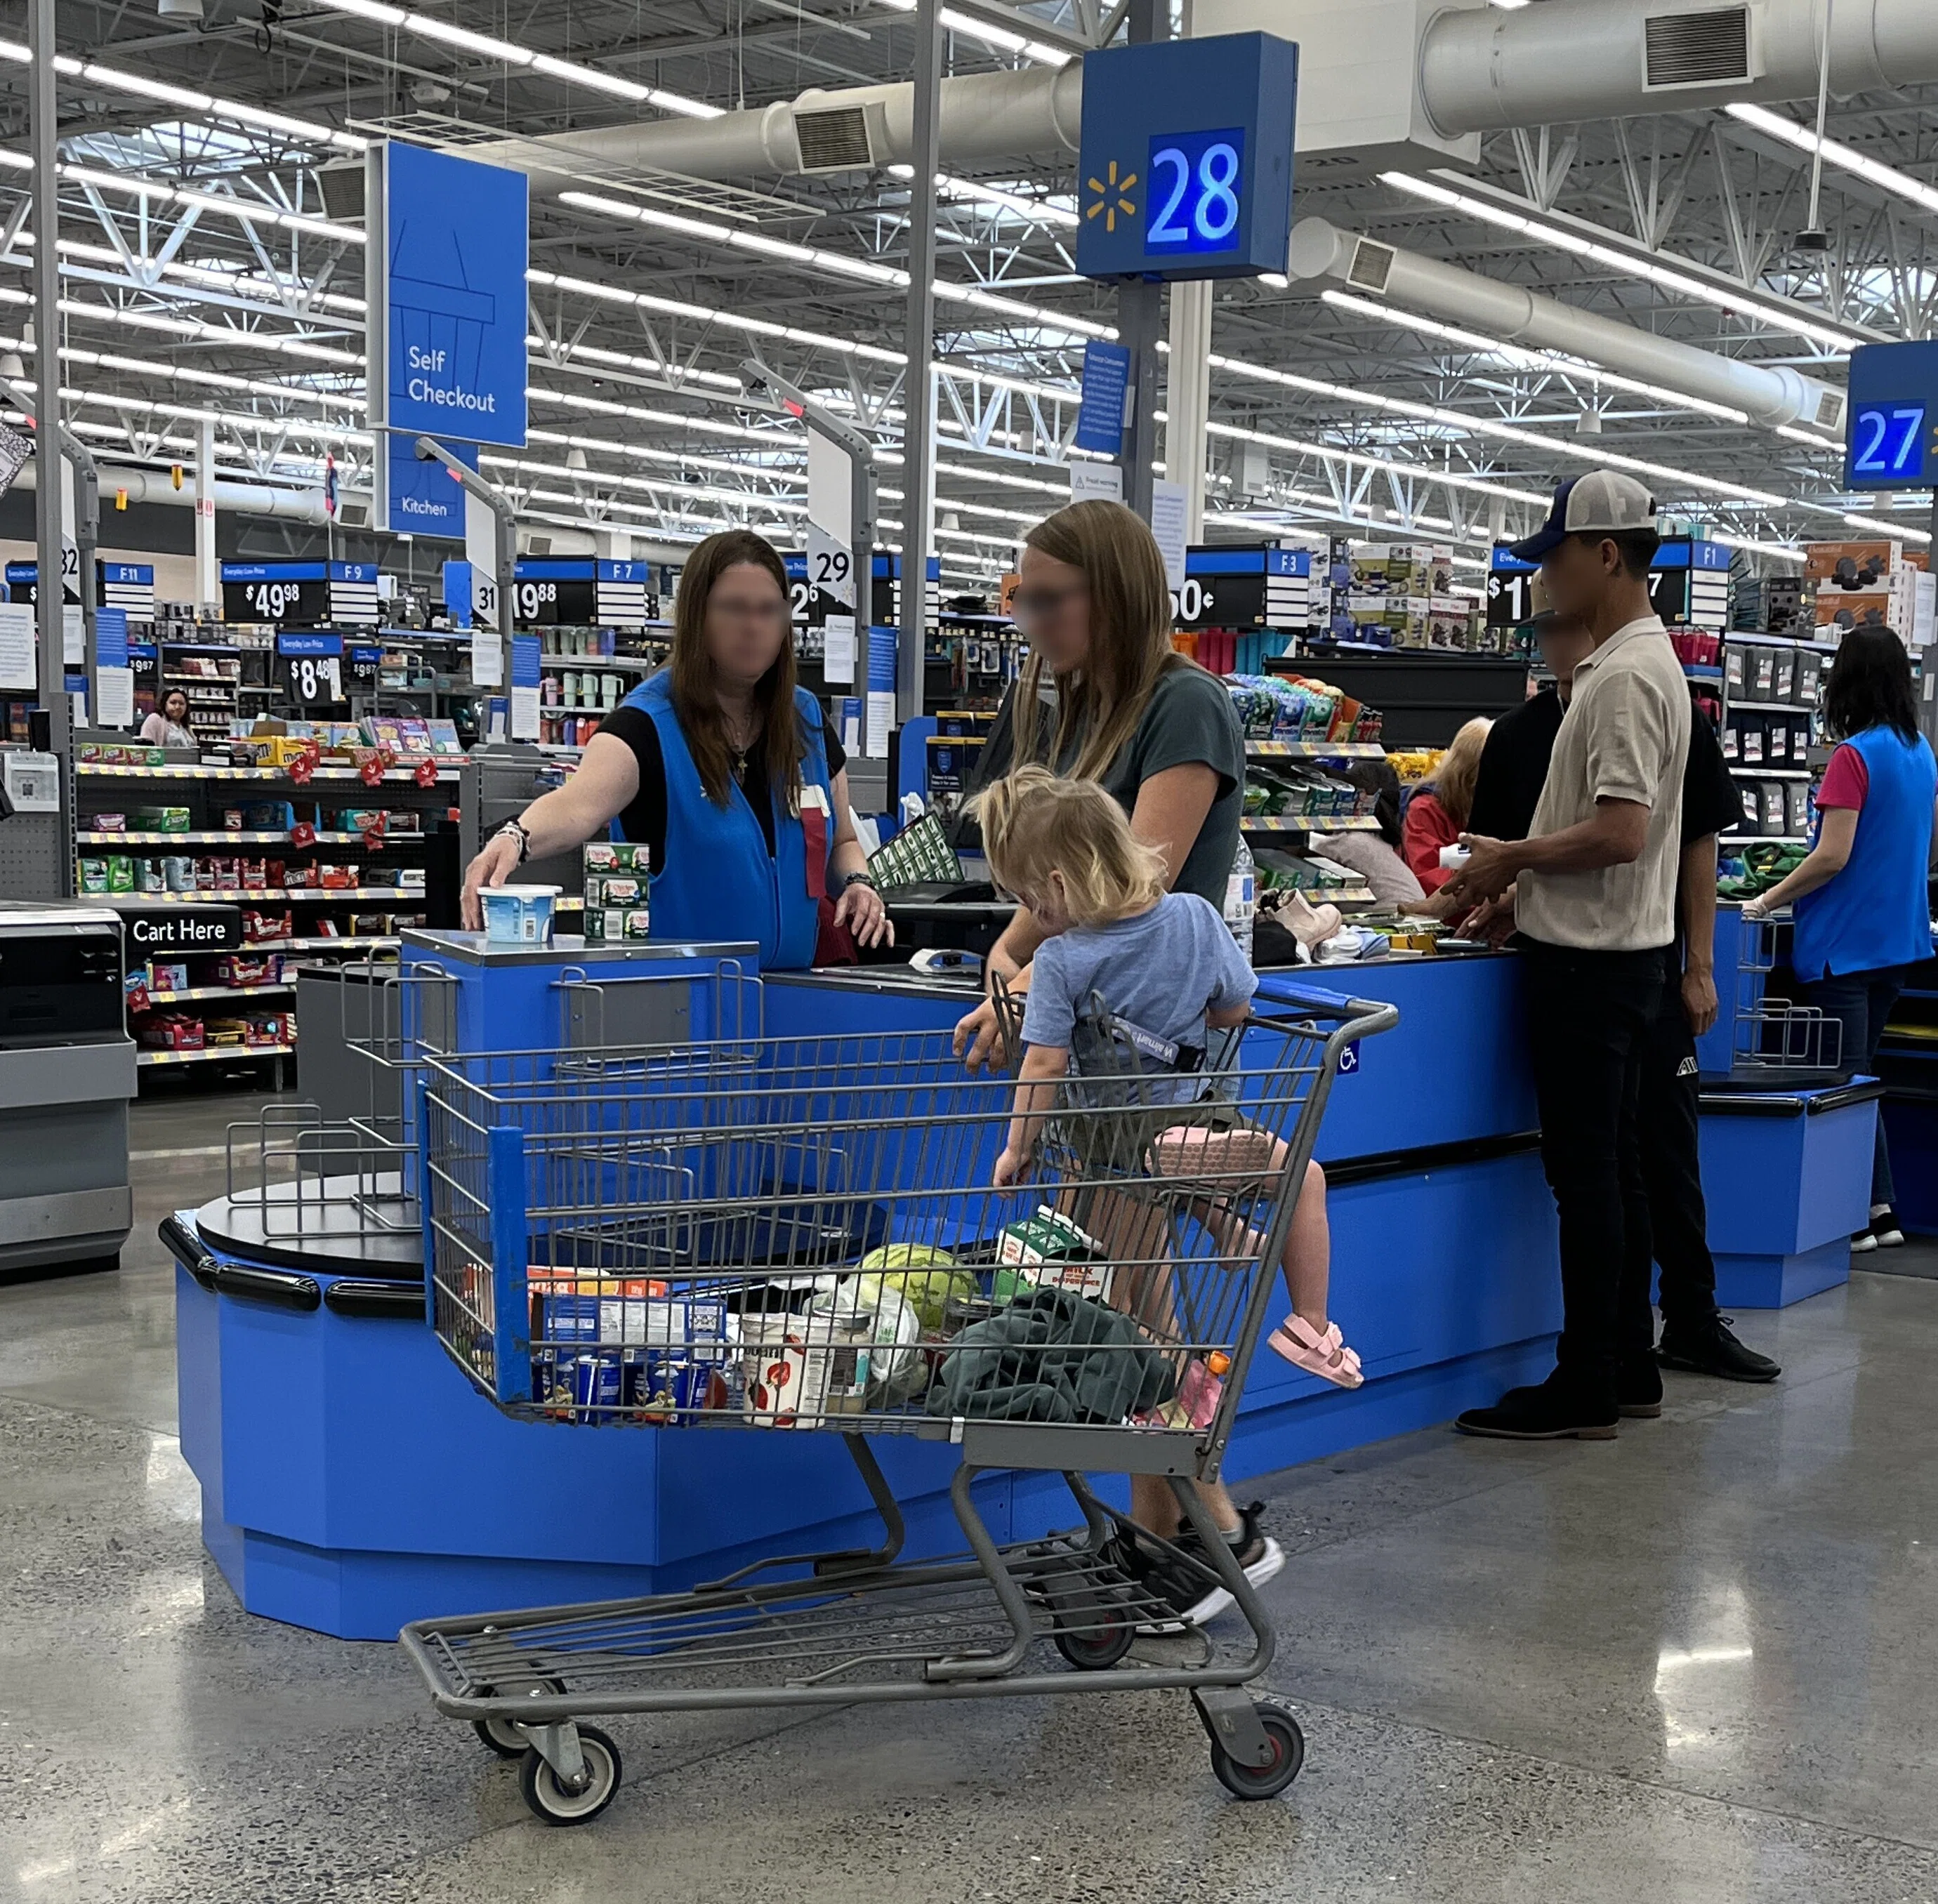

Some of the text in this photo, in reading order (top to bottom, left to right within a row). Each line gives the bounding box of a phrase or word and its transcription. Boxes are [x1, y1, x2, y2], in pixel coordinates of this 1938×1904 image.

[1147, 143, 1239, 243] 28
[409, 345, 445, 372] Self
[409, 378, 495, 413] Checkout
[1854, 408, 1924, 471] 27
[402, 497, 447, 517] Kitchen
[817, 552, 849, 582] 29
[479, 587, 494, 610] 31
[133, 919, 225, 941] Cart Here
